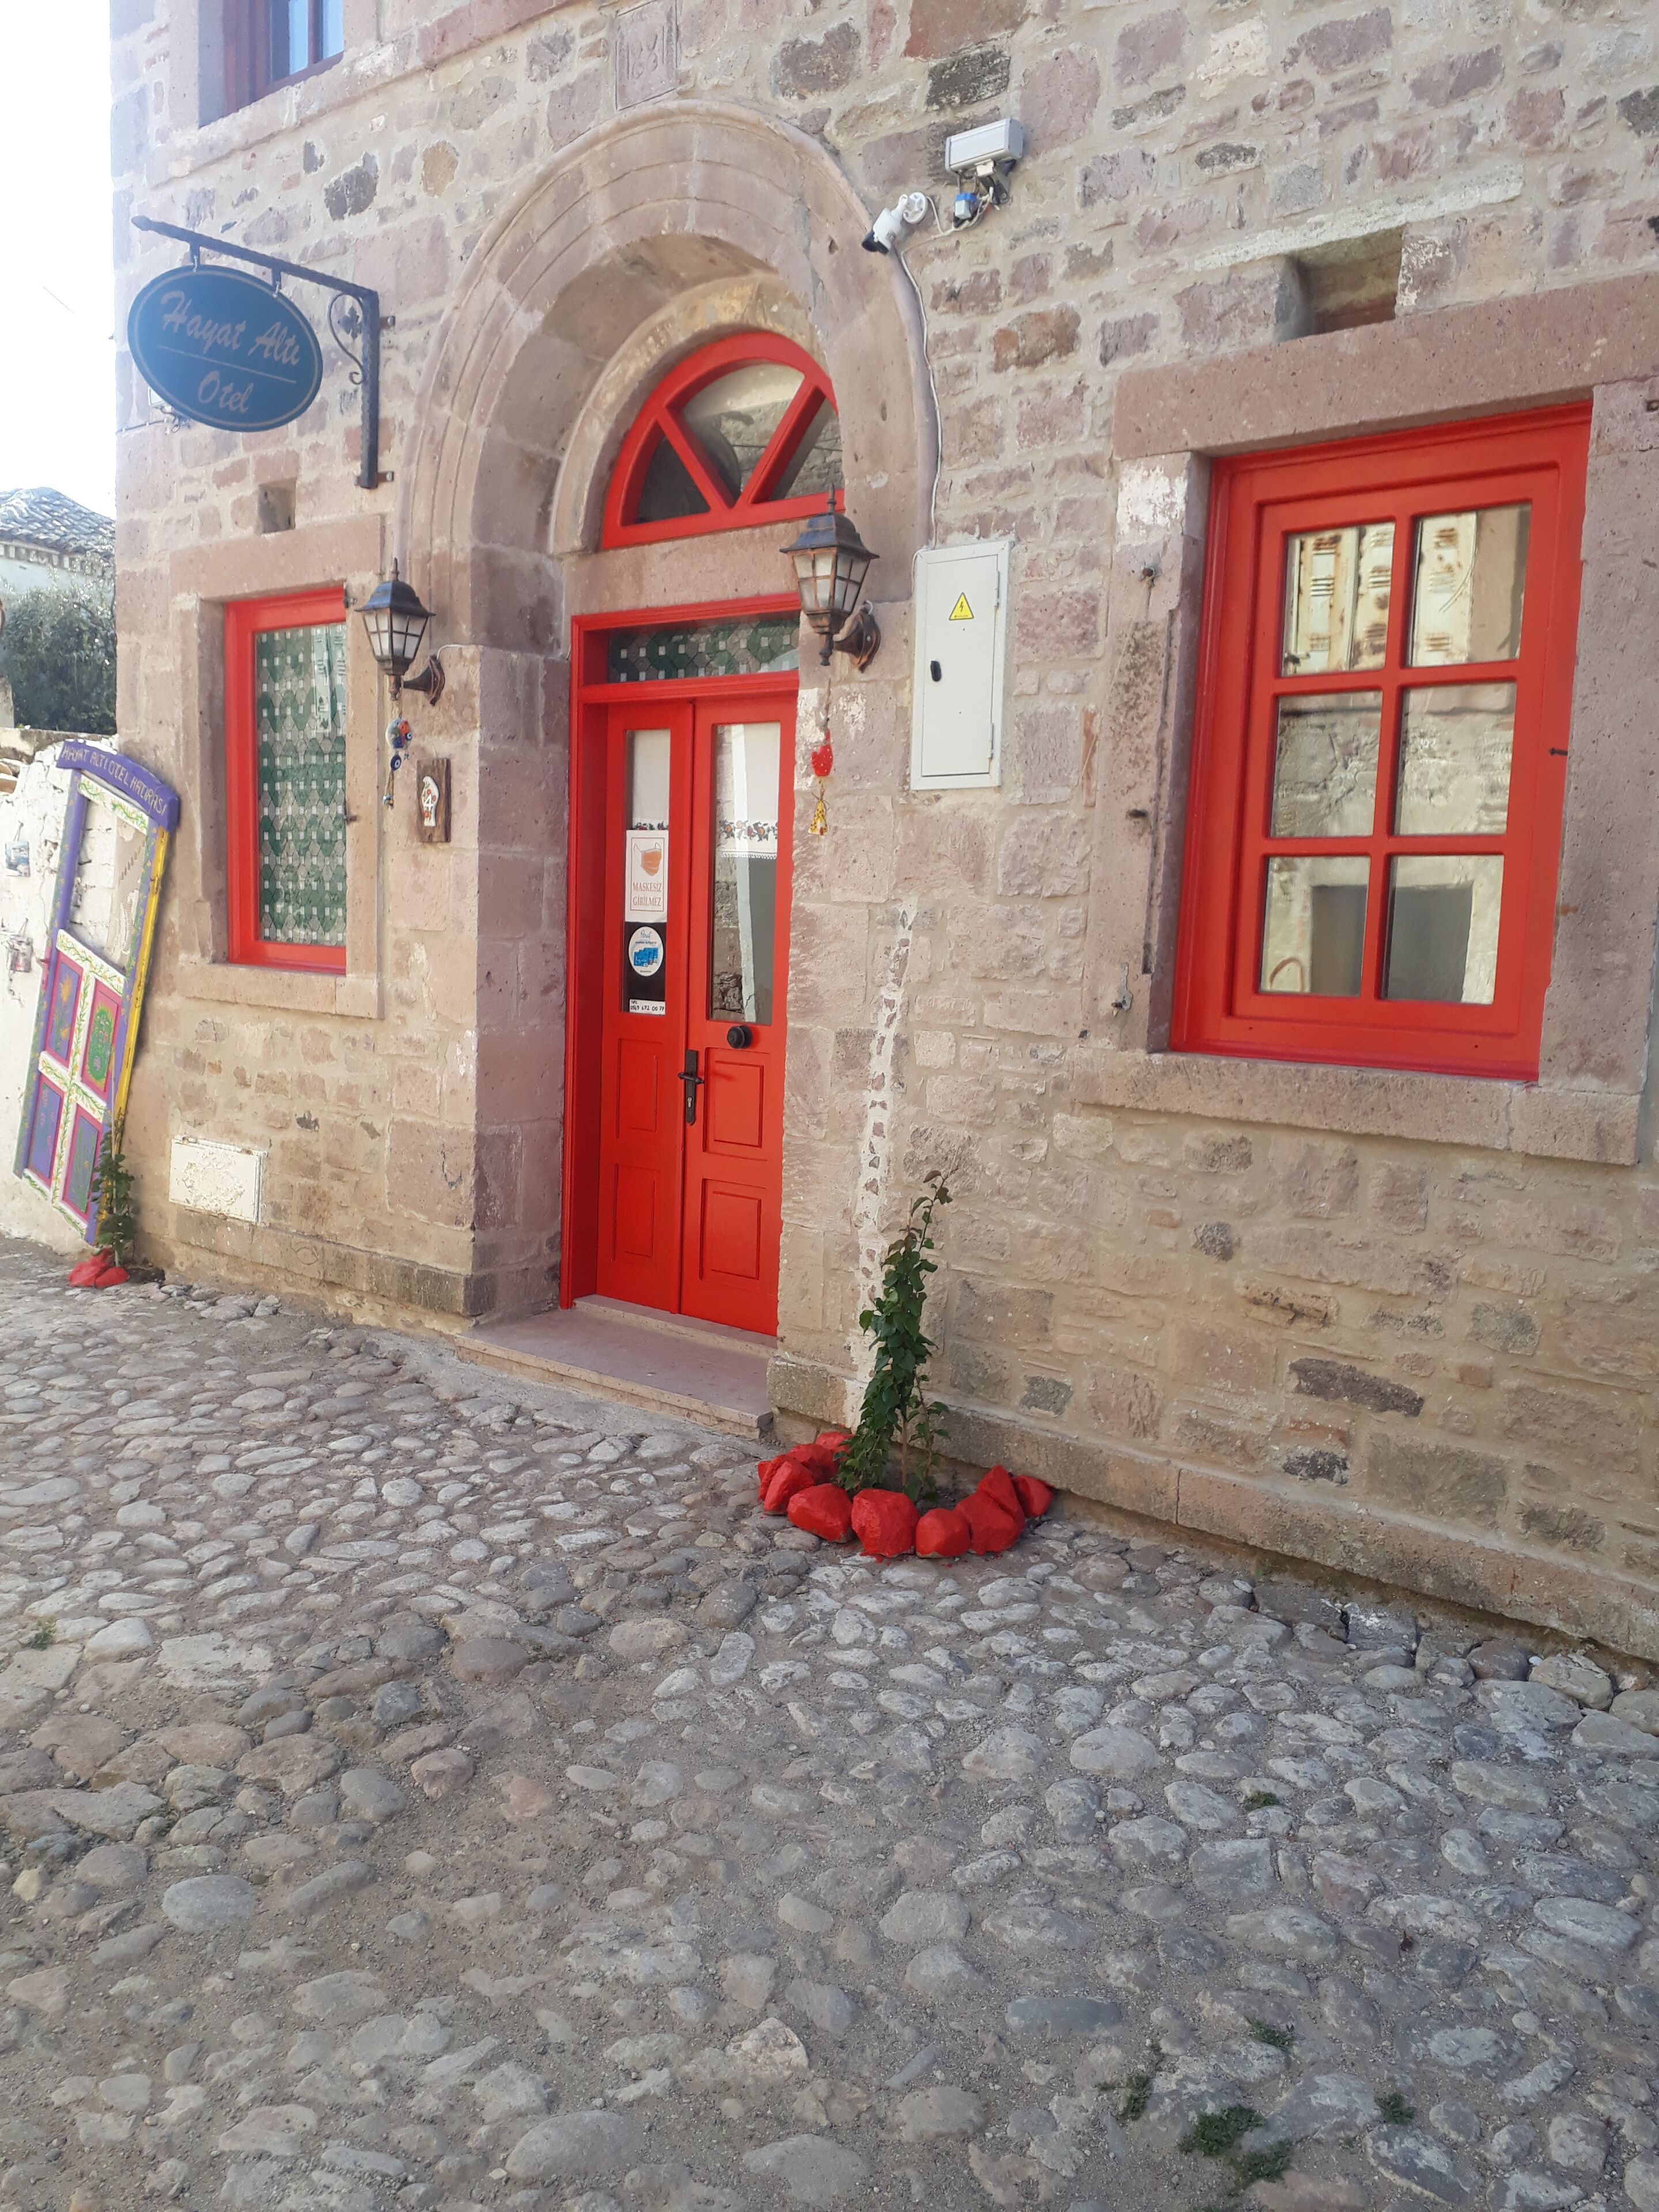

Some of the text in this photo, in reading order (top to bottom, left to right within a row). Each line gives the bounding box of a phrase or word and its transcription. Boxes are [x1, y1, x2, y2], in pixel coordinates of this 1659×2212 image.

[161, 290, 247, 353] Hayat
[198, 370, 254, 414] Otel
[61, 746, 167, 816] HAYAT ALTI OTEL HATIRASI
[424, 794, 433, 810] 4
[632, 881, 662, 892] MASKESİZ
